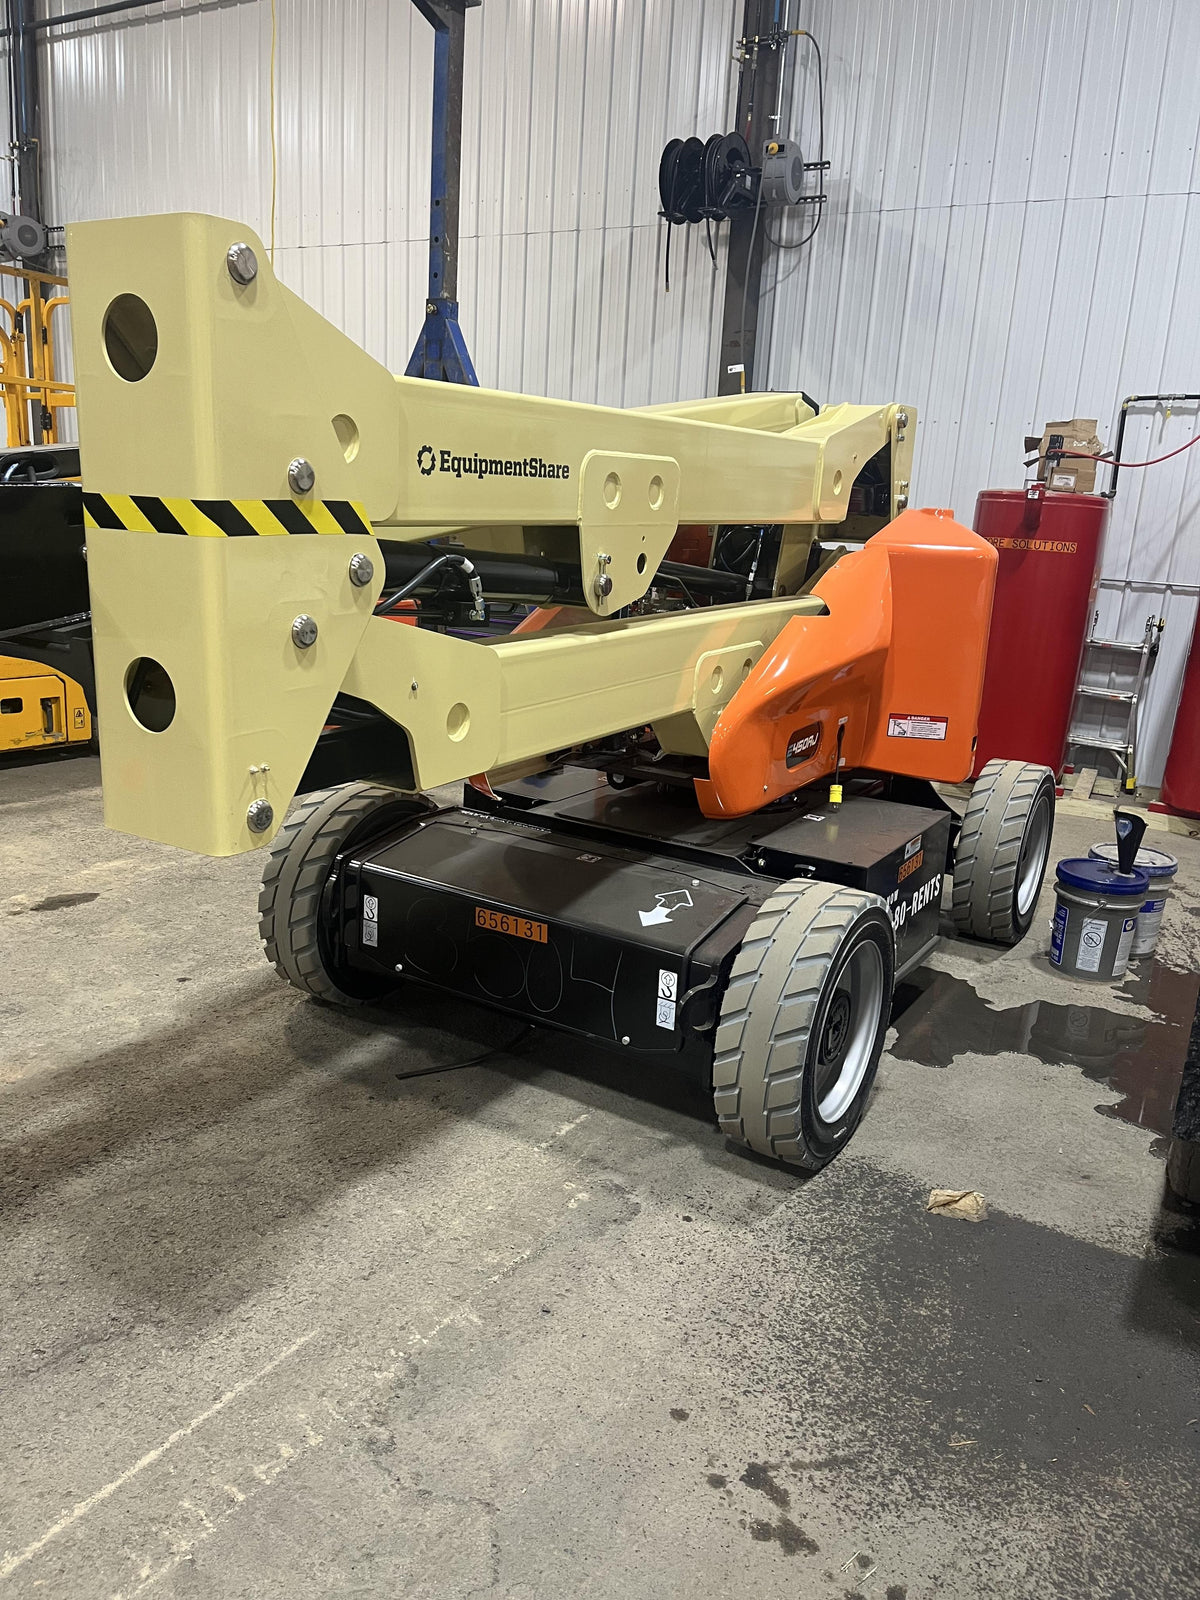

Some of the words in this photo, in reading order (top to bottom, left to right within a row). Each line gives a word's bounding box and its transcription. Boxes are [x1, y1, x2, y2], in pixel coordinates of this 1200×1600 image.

[439, 450, 570, 479] EquipmentShare
[1011, 539, 1078, 553] SOLUTIONS
[892, 873, 941, 931] 80-RENTS
[476, 909, 545, 942] 656131
